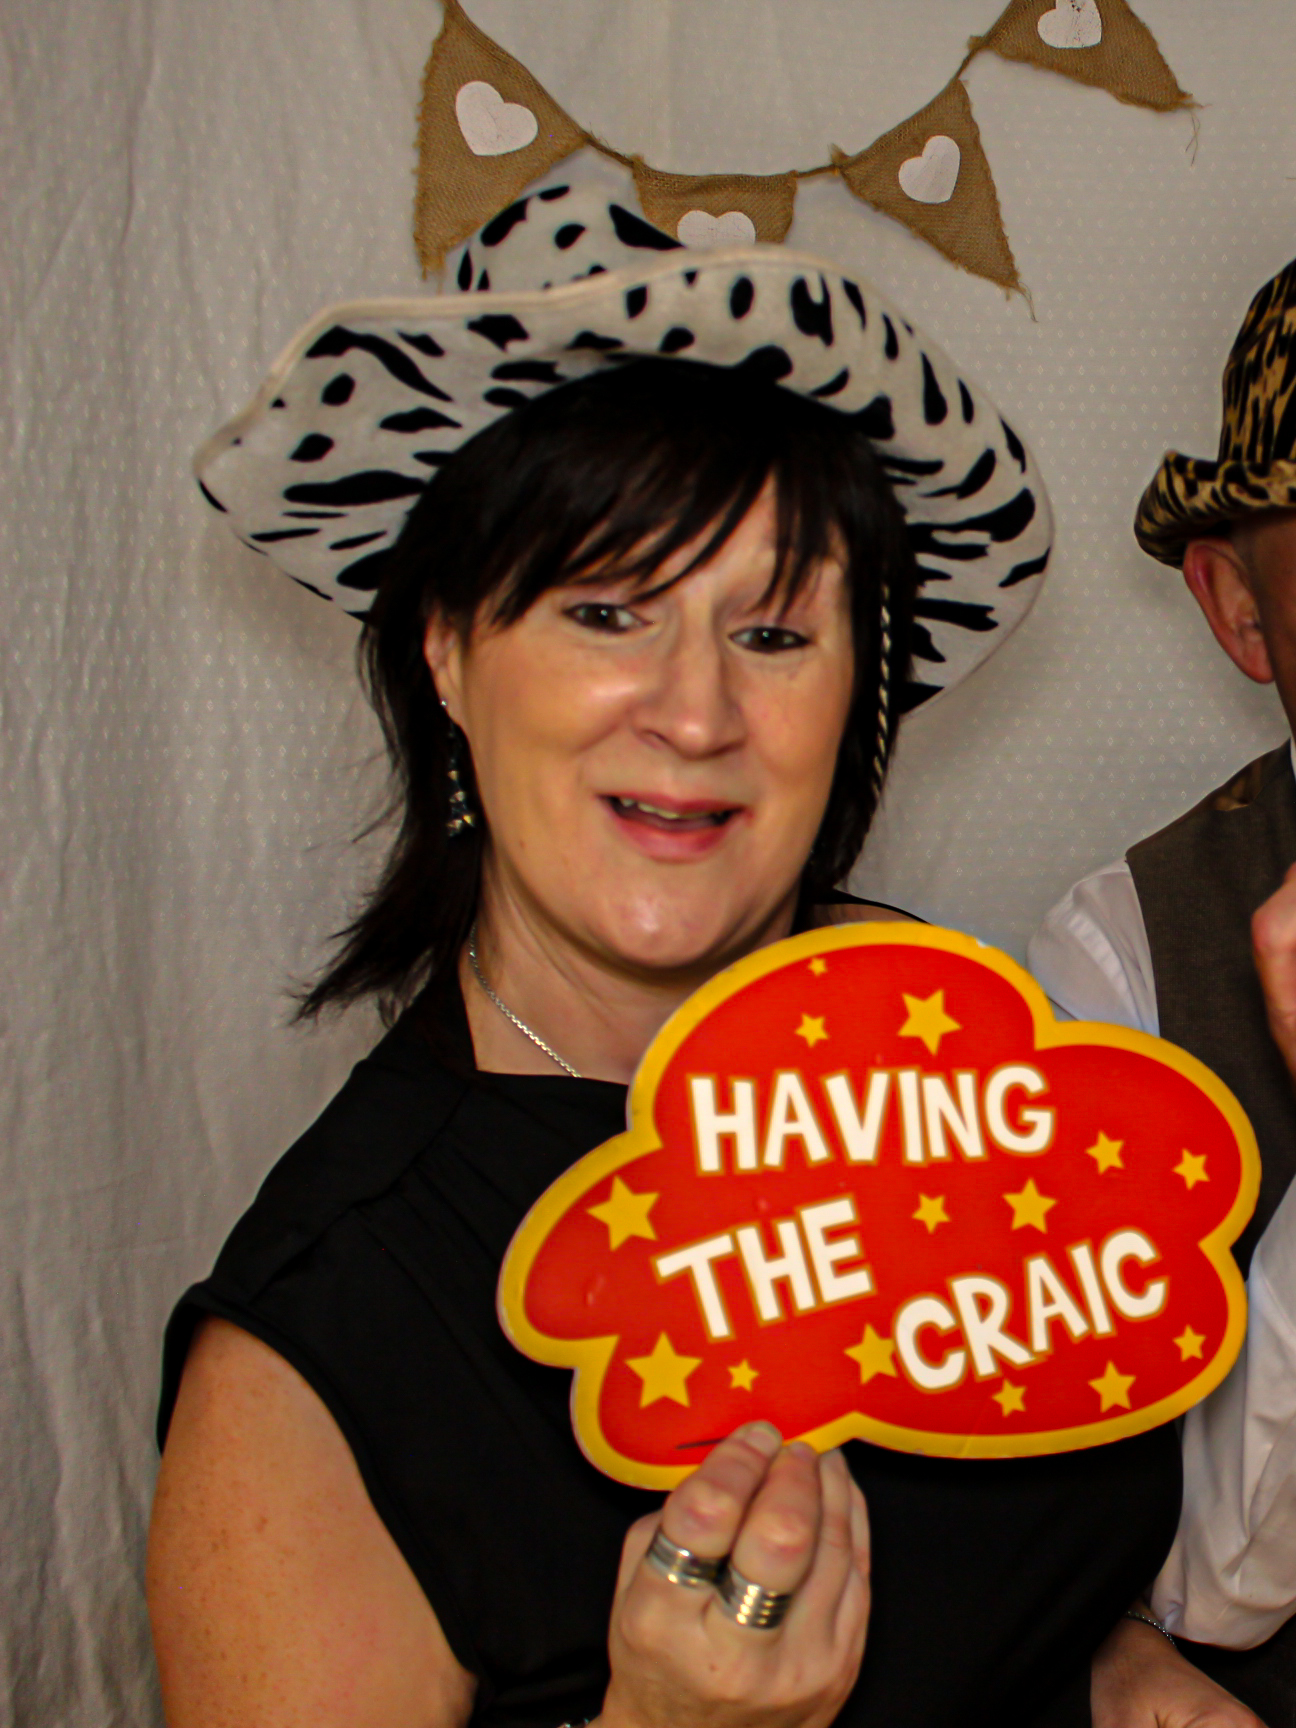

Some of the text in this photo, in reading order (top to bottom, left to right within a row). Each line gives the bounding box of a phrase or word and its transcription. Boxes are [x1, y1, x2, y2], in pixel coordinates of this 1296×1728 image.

[689, 1065, 1054, 1172] HAVING
[656, 1198, 873, 1339] THE
[895, 1230, 1166, 1390] CRAIC
